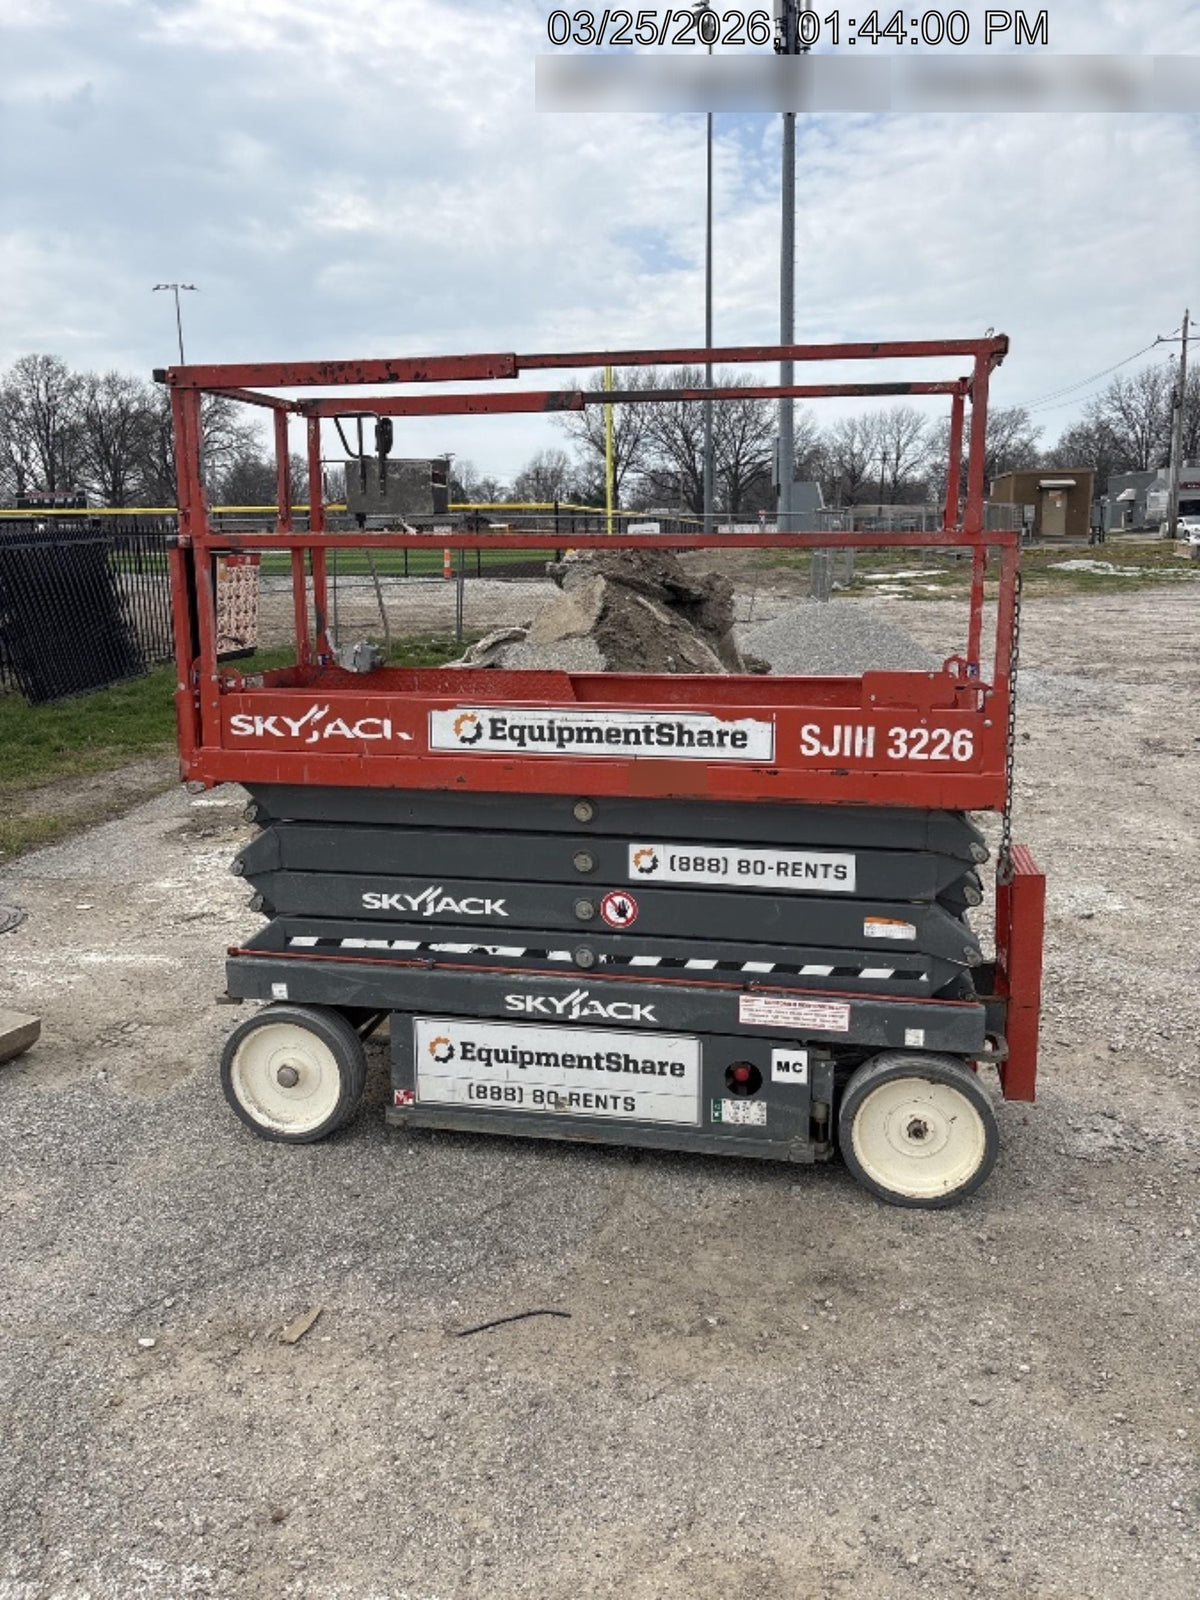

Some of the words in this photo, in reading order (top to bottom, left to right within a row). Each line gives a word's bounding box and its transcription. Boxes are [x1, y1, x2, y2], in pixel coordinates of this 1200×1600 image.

[488, 717, 748, 749] EquipmentShare
[887, 726, 973, 762] 3226
[669, 854, 729, 875] (888)
[737, 859, 848, 881] 80-RENTS
[361, 885, 509, 917] SKYJACK
[504, 988, 658, 1023] SKYJACK
[459, 1041, 686, 1078] EquipmentShare
[776, 1061, 803, 1073] MC
[467, 1083, 523, 1104] (888)
